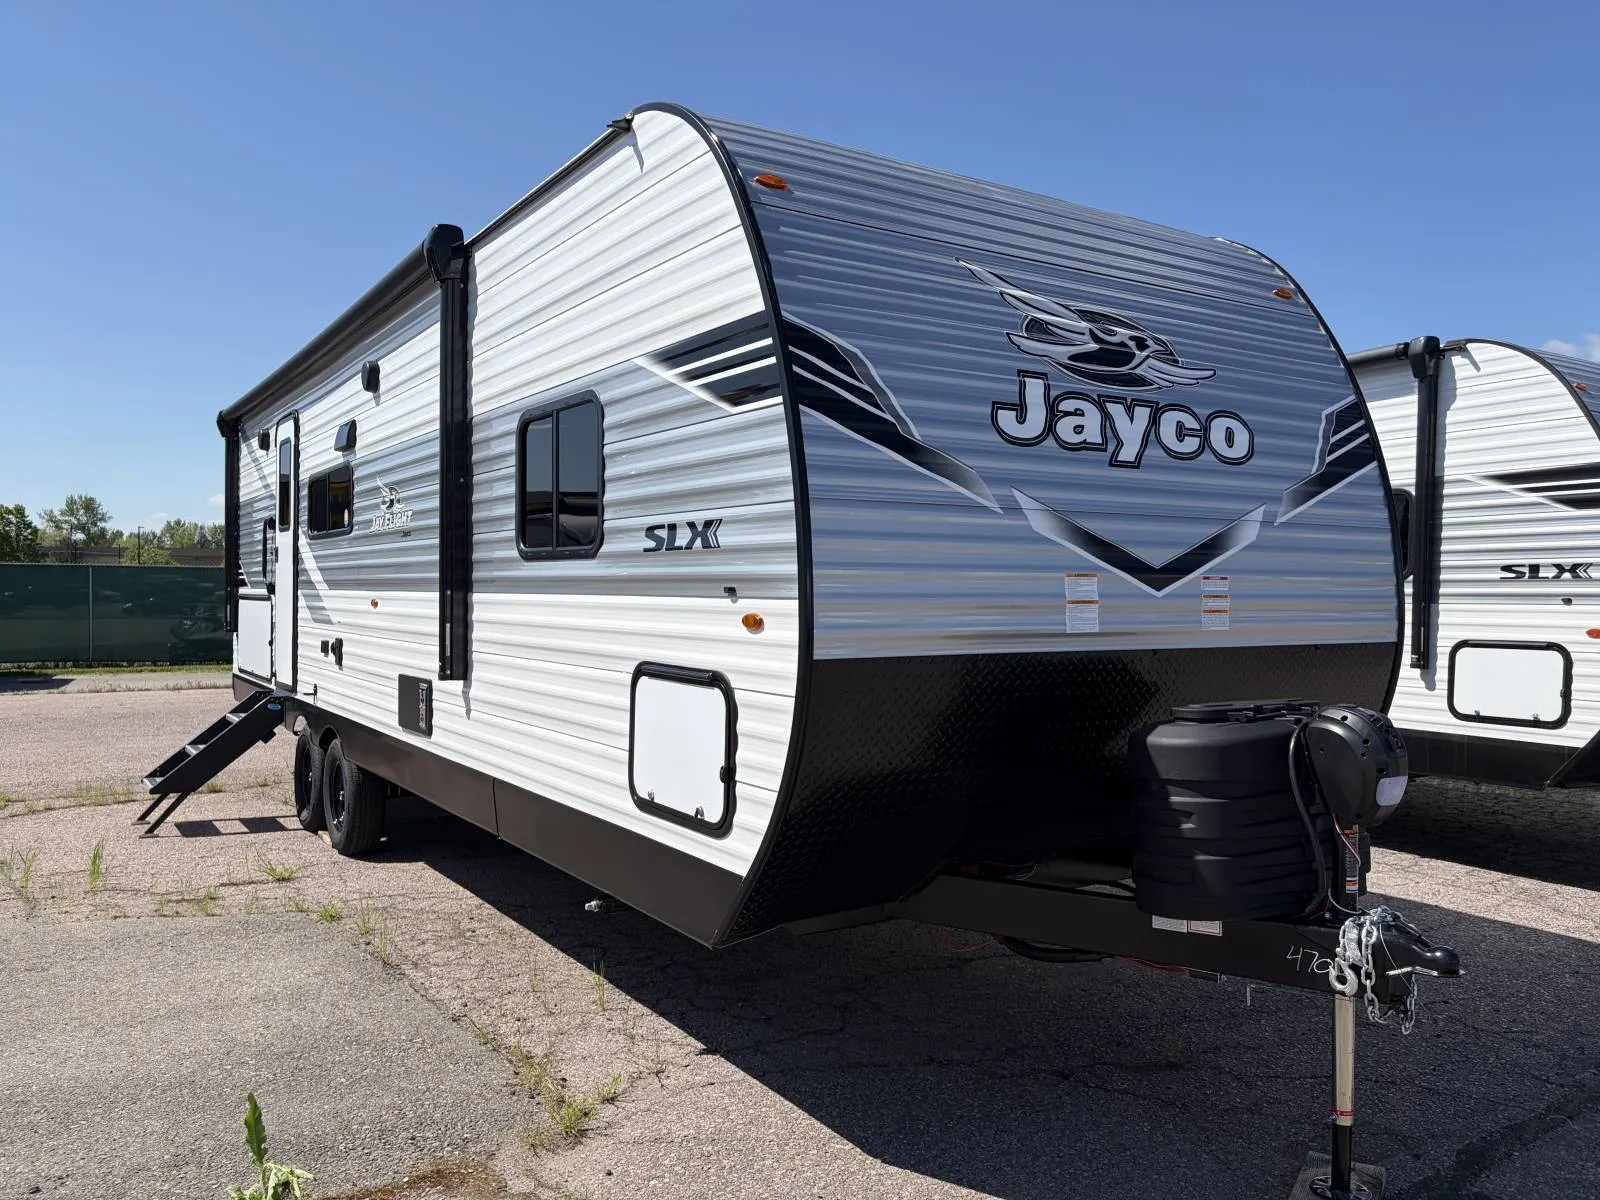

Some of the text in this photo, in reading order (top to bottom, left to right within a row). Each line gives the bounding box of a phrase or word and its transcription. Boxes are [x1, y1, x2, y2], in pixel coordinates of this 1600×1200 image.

[991, 369, 1254, 468] Jayco
[369, 509, 413, 532] JAY FLIGHT
[643, 518, 722, 552] SLX
[1499, 563, 1593, 580] SLX
